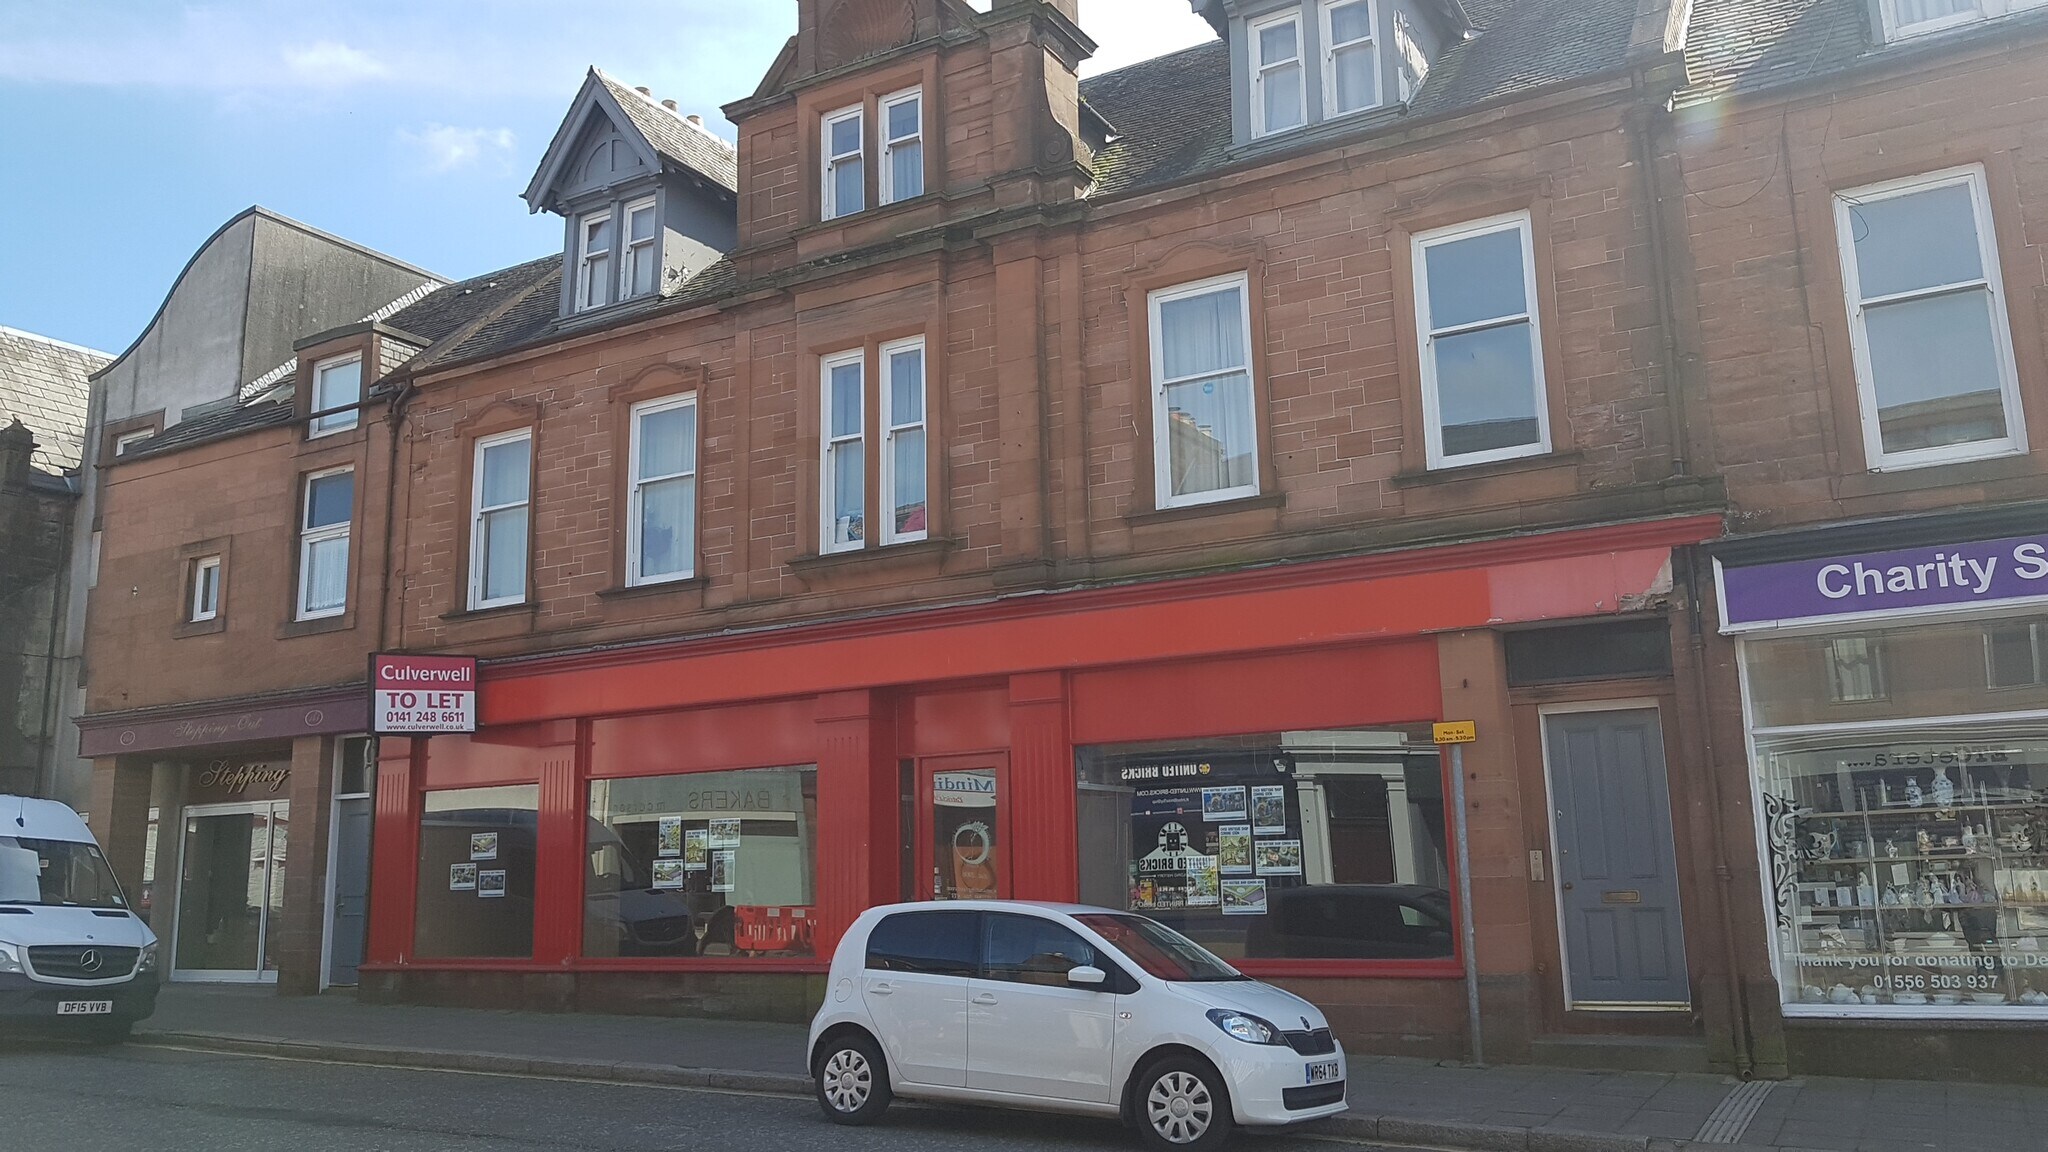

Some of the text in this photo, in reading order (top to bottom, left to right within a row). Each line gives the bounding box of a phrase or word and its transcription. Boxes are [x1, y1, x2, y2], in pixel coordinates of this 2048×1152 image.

[1816, 551, 1998, 599] Charity
[381, 664, 470, 682] Culverwell
[386, 692, 464, 709] TO LET
[386, 711, 464, 722] 0141 248 6611
[1847, 956, 1880, 970] you
[1886, 953, 1909, 967] for
[1914, 953, 1994, 970] donating
[2000, 953, 2018, 966] to
[1873, 974, 1998, 989] 01556 503 937
[64, 1002, 107, 1013] DF15 VVB
[1311, 1065, 1327, 1080] WR64
